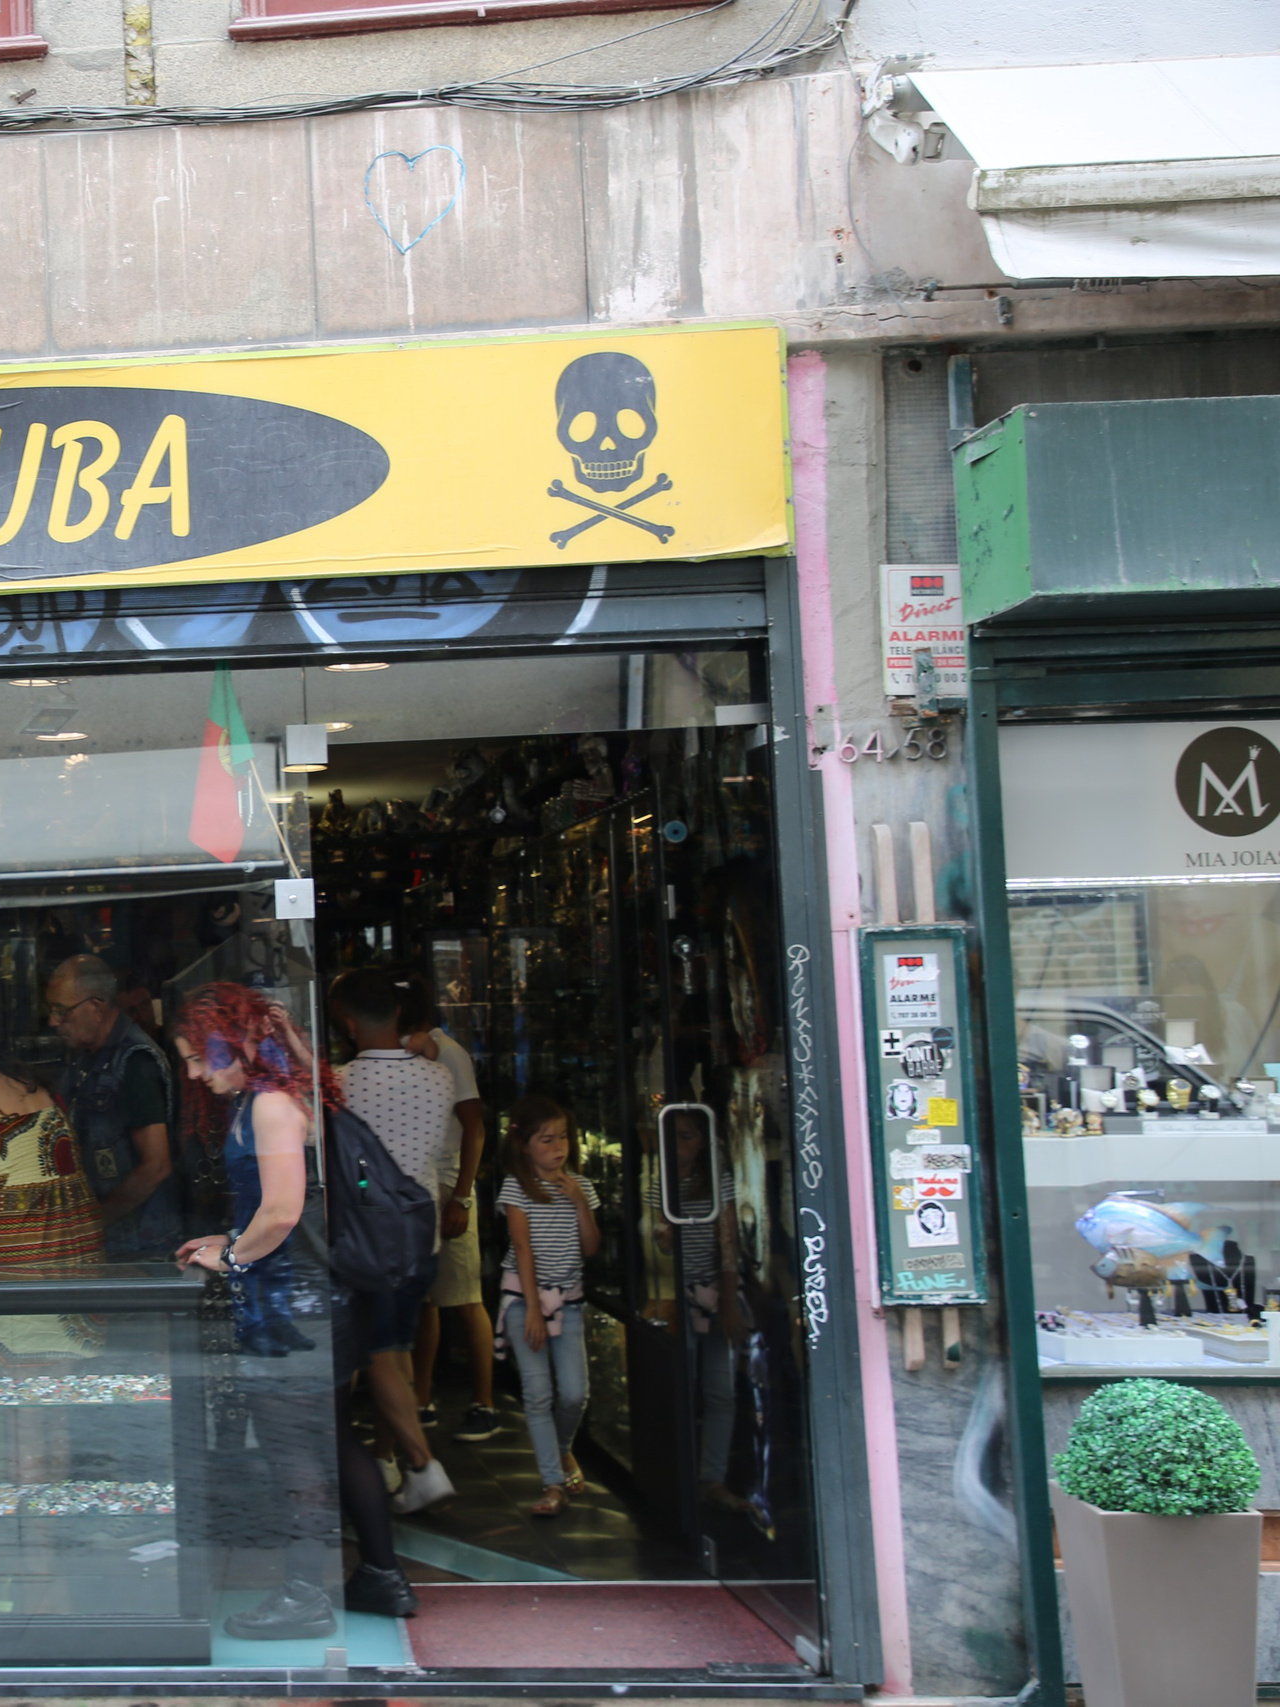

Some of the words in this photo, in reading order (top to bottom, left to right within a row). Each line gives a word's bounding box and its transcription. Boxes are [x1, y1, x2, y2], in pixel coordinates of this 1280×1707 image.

[898, 596, 961, 622] Direct
[1185, 852, 1227, 868] MIA
[890, 993, 937, 1003] ALARME
